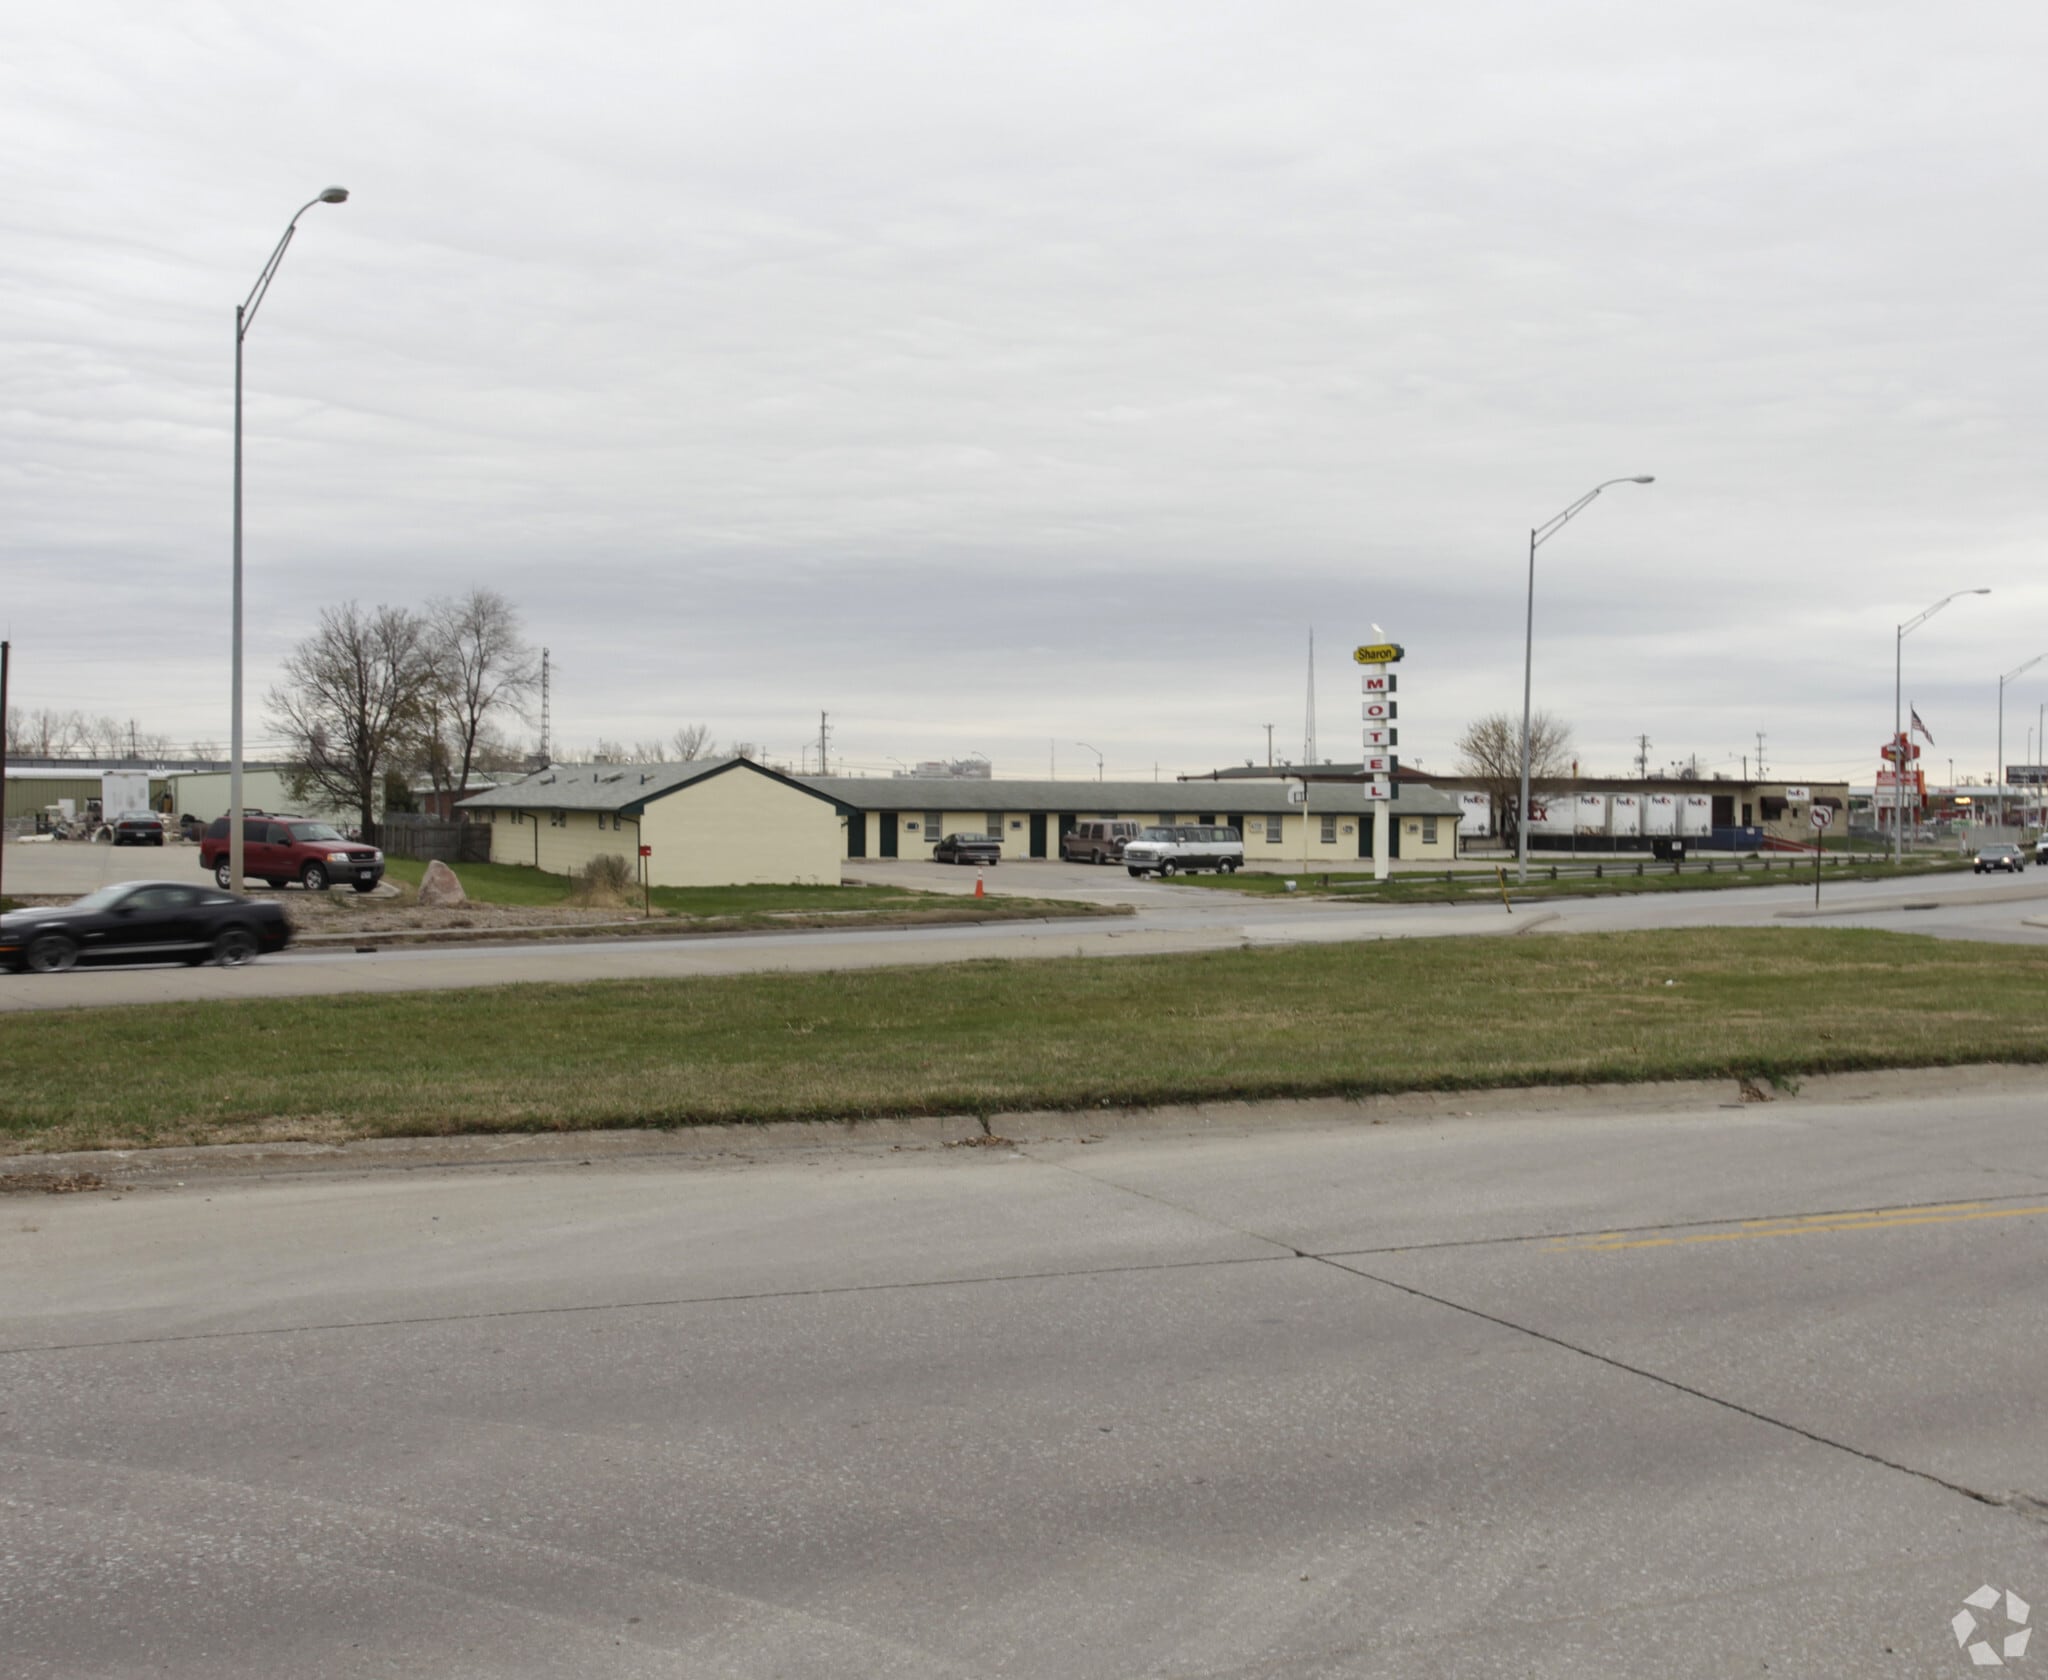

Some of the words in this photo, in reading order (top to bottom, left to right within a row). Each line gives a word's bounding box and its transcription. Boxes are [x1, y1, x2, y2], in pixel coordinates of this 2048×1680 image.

[1358, 648, 1392, 660] Sharon
[1366, 678, 1384, 797] MOTEL
[1581, 796, 1600, 806] FedEx
[1617, 797, 1635, 806] FedEx
[1652, 796, 1671, 805] FedEx
[1688, 797, 1706, 806] FedEx
